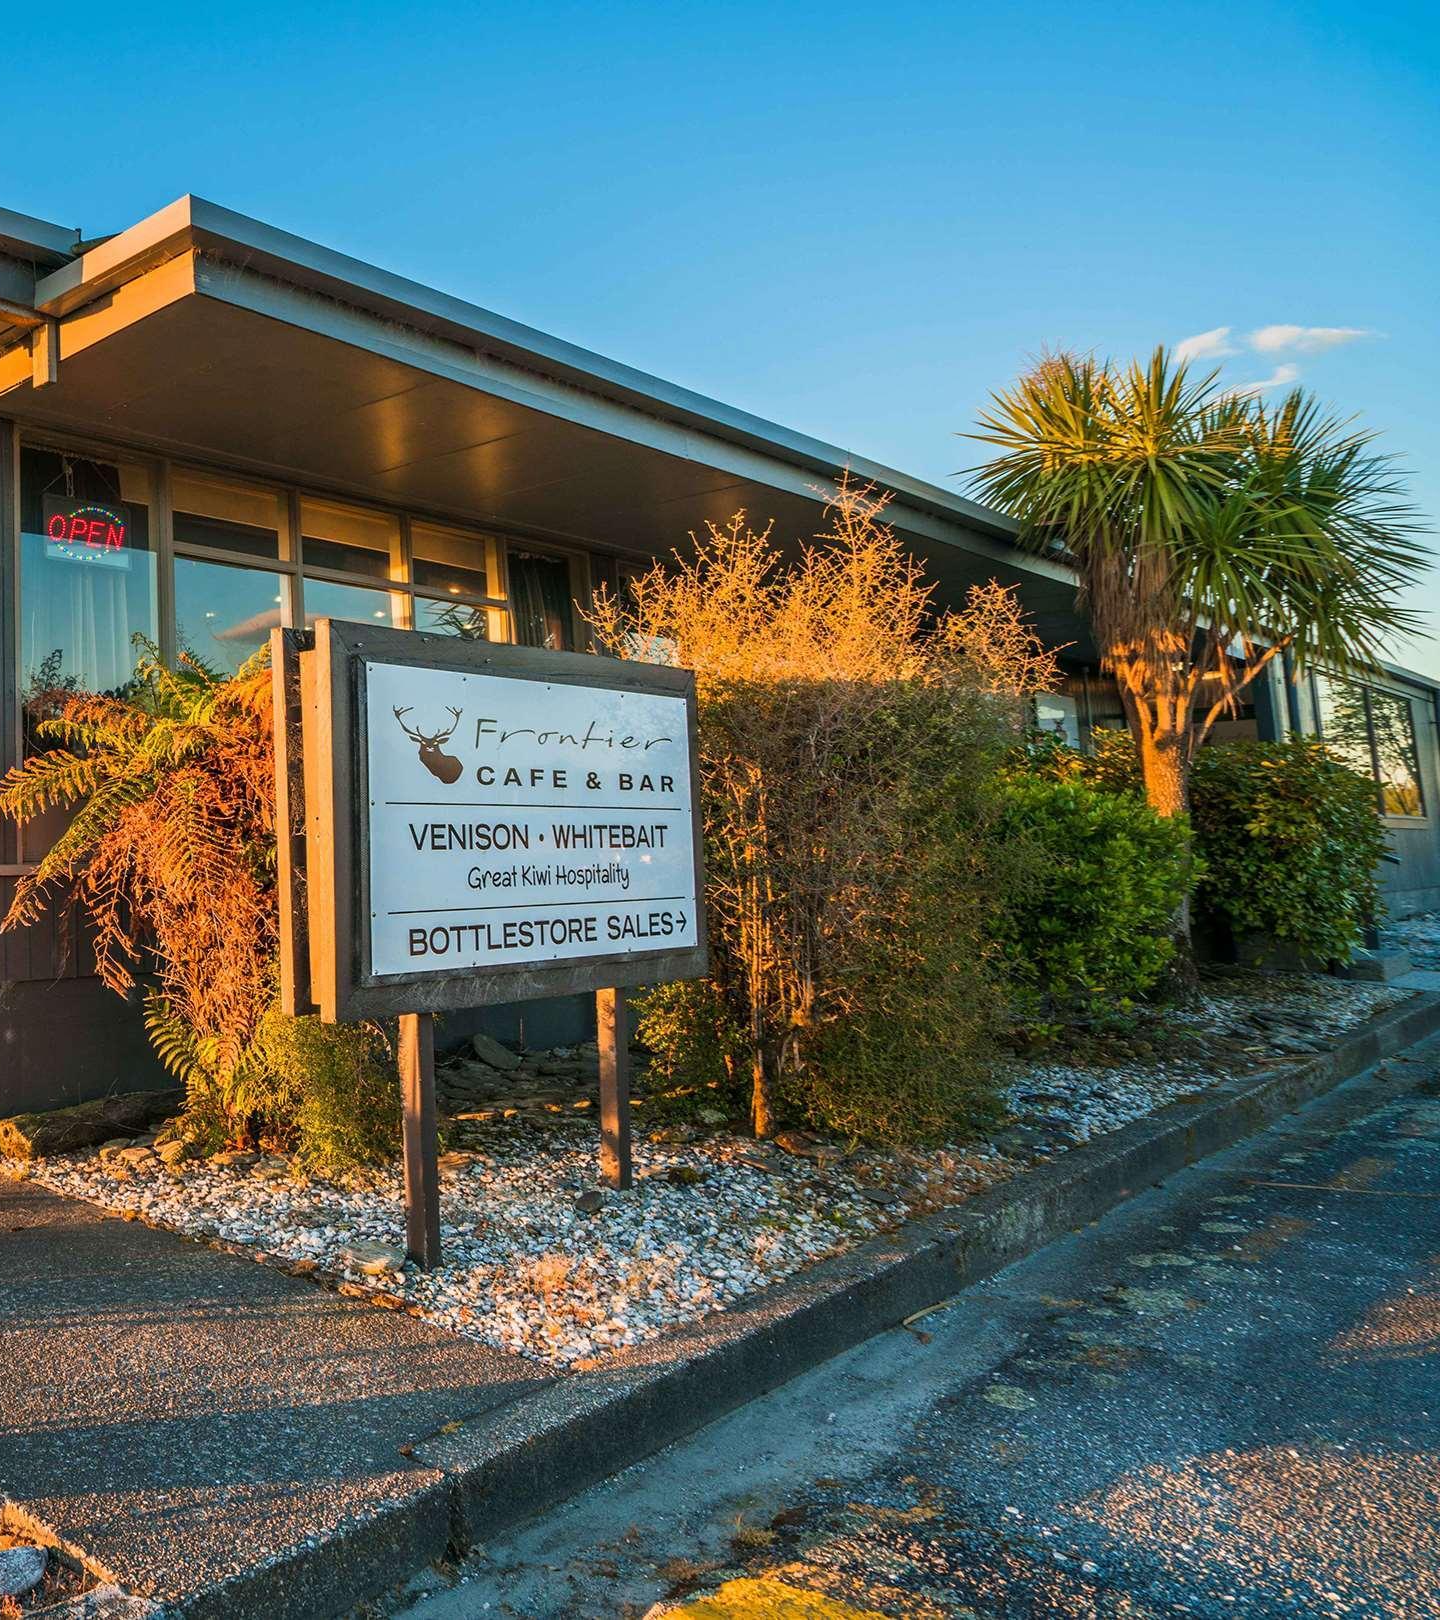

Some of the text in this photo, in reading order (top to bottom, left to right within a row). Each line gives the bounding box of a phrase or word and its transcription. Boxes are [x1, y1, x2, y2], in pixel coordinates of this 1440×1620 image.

[47, 513, 126, 551] OPEN
[474, 718, 673, 752] Frontier
[476, 765, 675, 793] CAFE & BAR
[409, 823, 668, 851] VENISON WHITEBAIT
[468, 863, 630, 890] Great Kiwi Hospitality
[409, 911, 674, 957] BOTTLESTORE SALES
